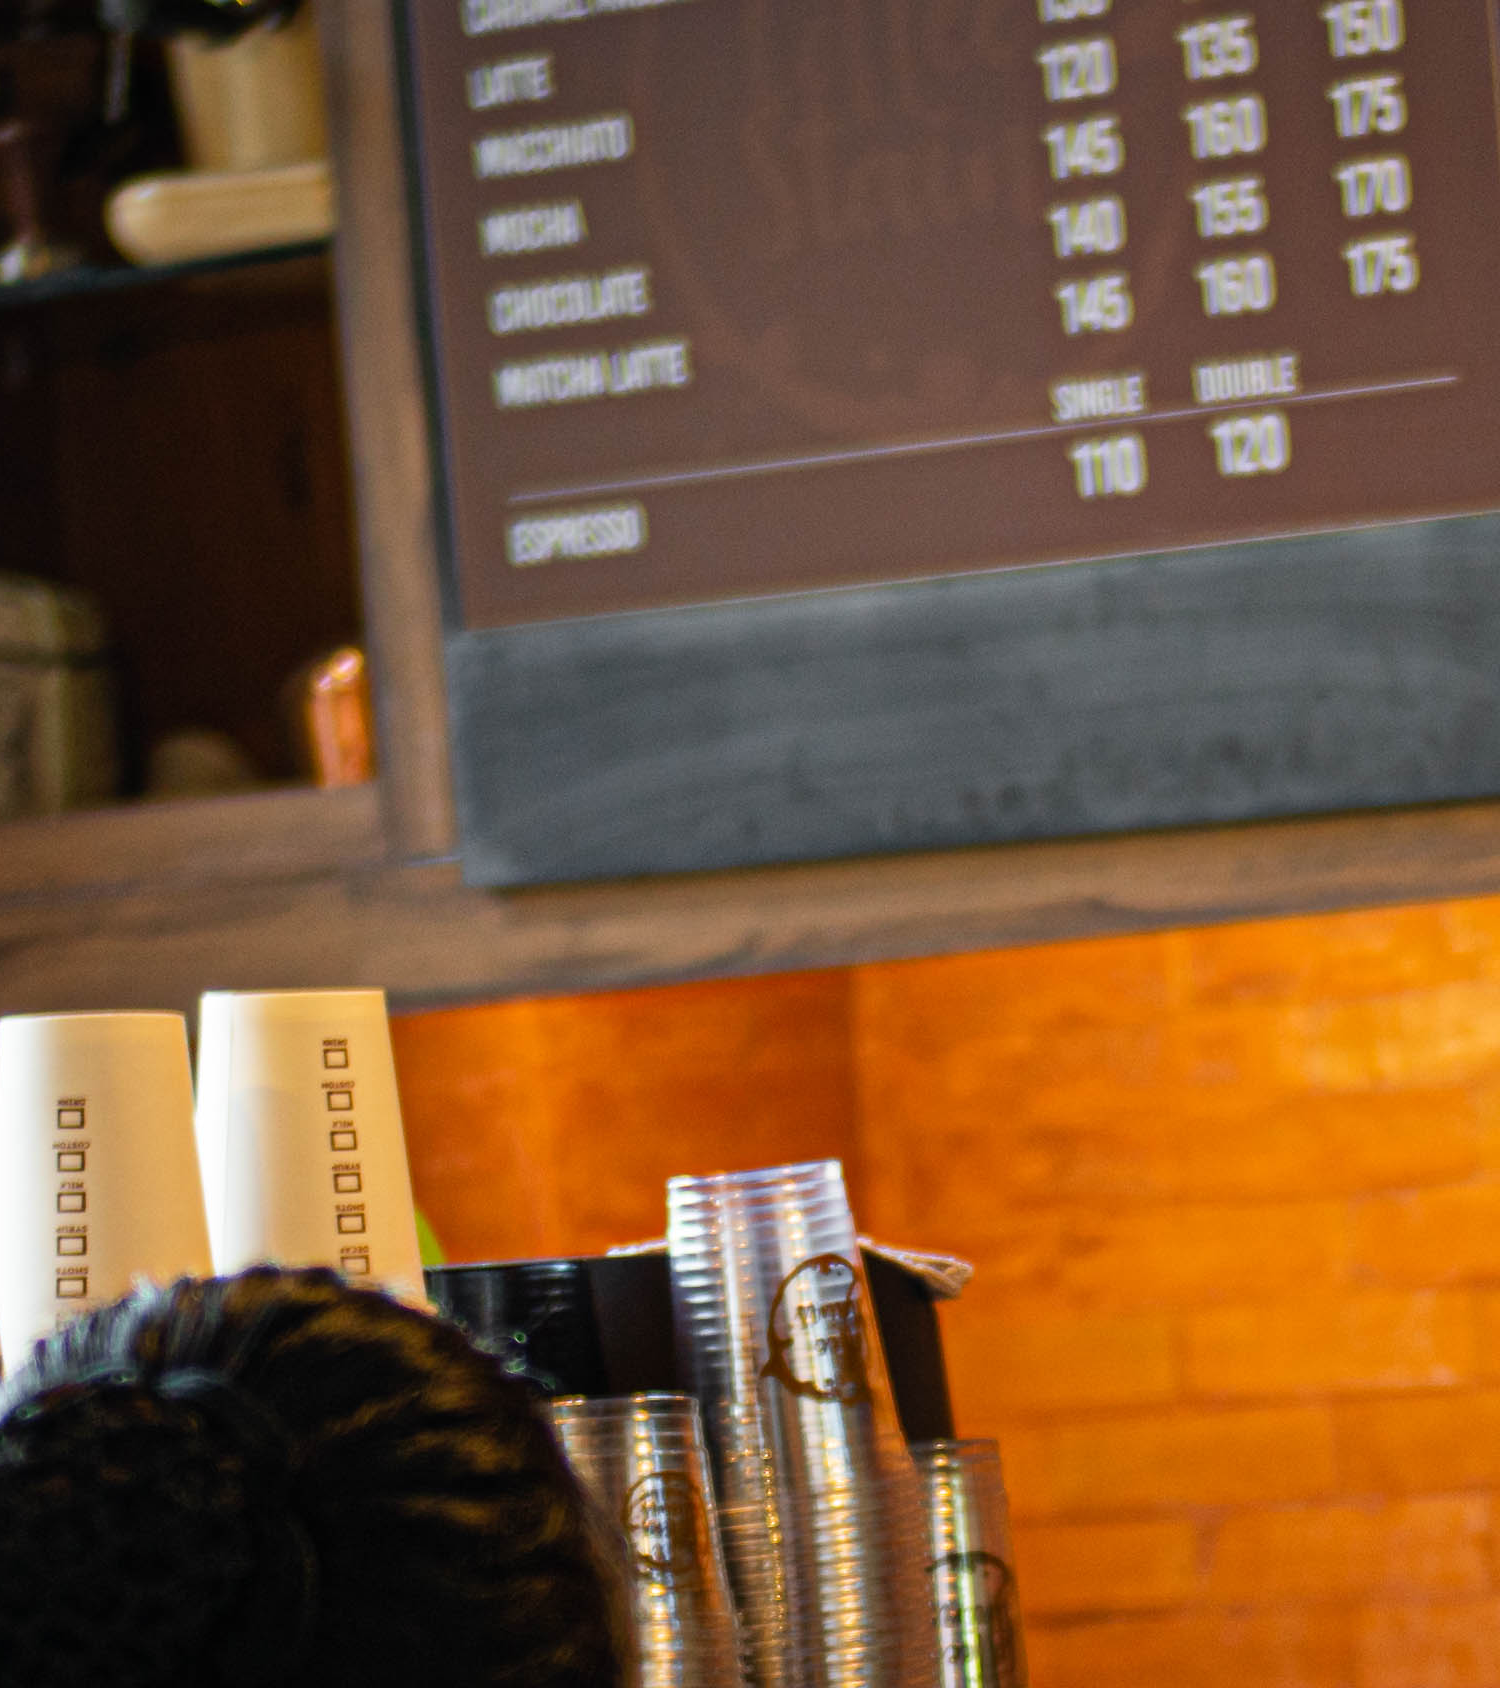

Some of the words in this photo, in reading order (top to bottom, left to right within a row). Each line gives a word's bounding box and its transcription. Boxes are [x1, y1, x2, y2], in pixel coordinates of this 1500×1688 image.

[1038, 39, 1116, 100] 120
[1177, 16, 1257, 79] 135
[1323, 0, 1403, 57] 150
[1044, 117, 1123, 179] 145
[1185, 96, 1266, 158] 160
[1329, 75, 1406, 137] 175
[490, 267, 650, 334] CHOCOLATE
[1049, 197, 1126, 258] 140
[1191, 177, 1268, 237] 155
[1336, 157, 1412, 216] 170
[495, 356, 602, 409] MATCHA
[607, 339, 689, 397] LATTE
[1057, 274, 1134, 335] 145
[1196, 256, 1277, 316] 160
[1344, 235, 1420, 296] 175
[1053, 374, 1144, 422] SINGLE
[1197, 354, 1297, 401] DOUBLE
[509, 504, 644, 566] ESPRESSO
[1072, 436, 1148, 497] 110
[1211, 414, 1290, 475] 120
